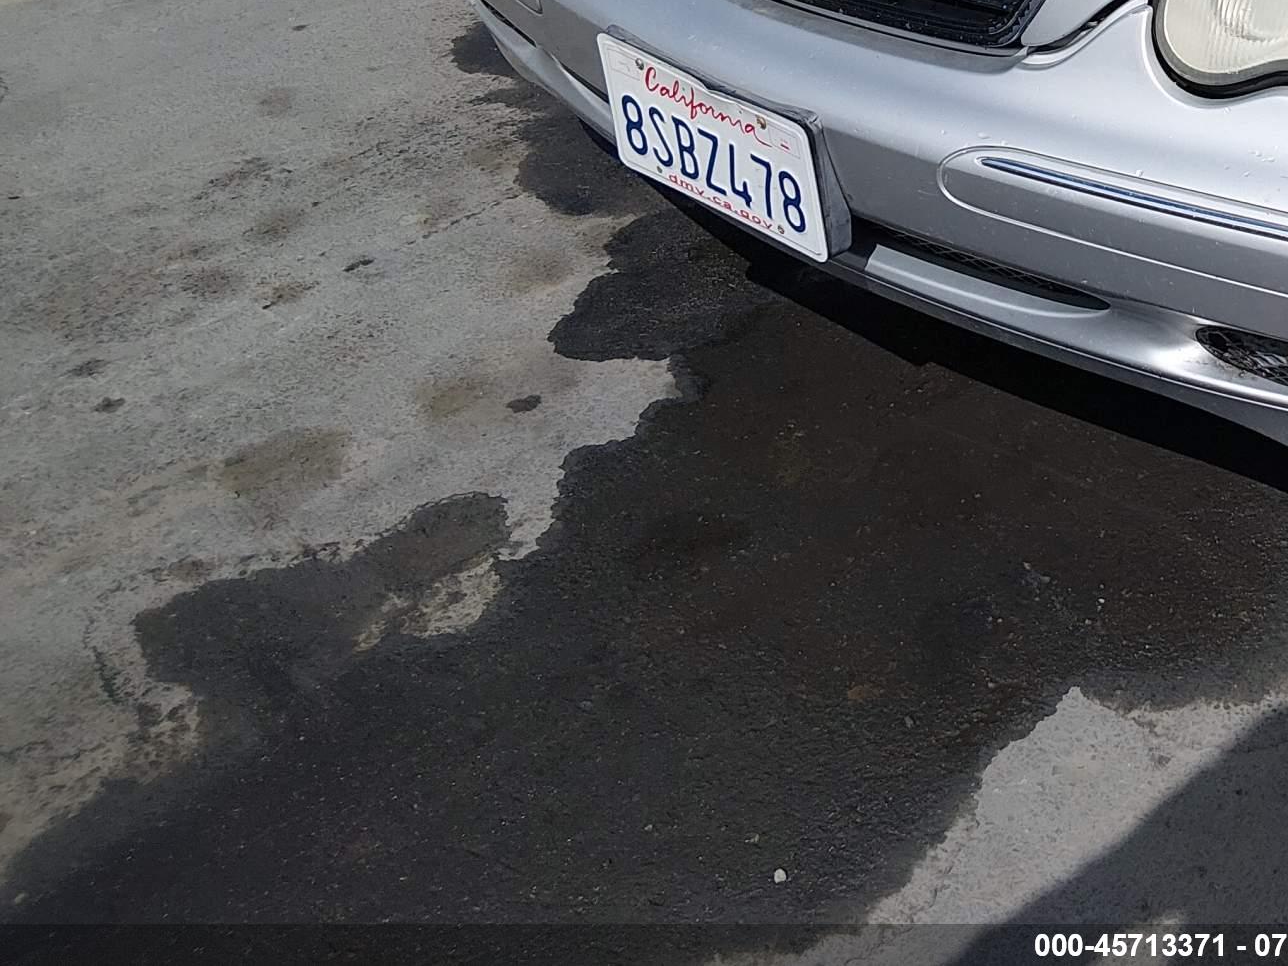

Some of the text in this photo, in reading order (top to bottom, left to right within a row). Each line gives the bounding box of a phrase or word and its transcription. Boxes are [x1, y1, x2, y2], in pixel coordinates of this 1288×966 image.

[645, 66, 772, 148] California
[621, 94, 806, 233] 8SBZ478
[668, 173, 773, 230] dmv.ca.gov
